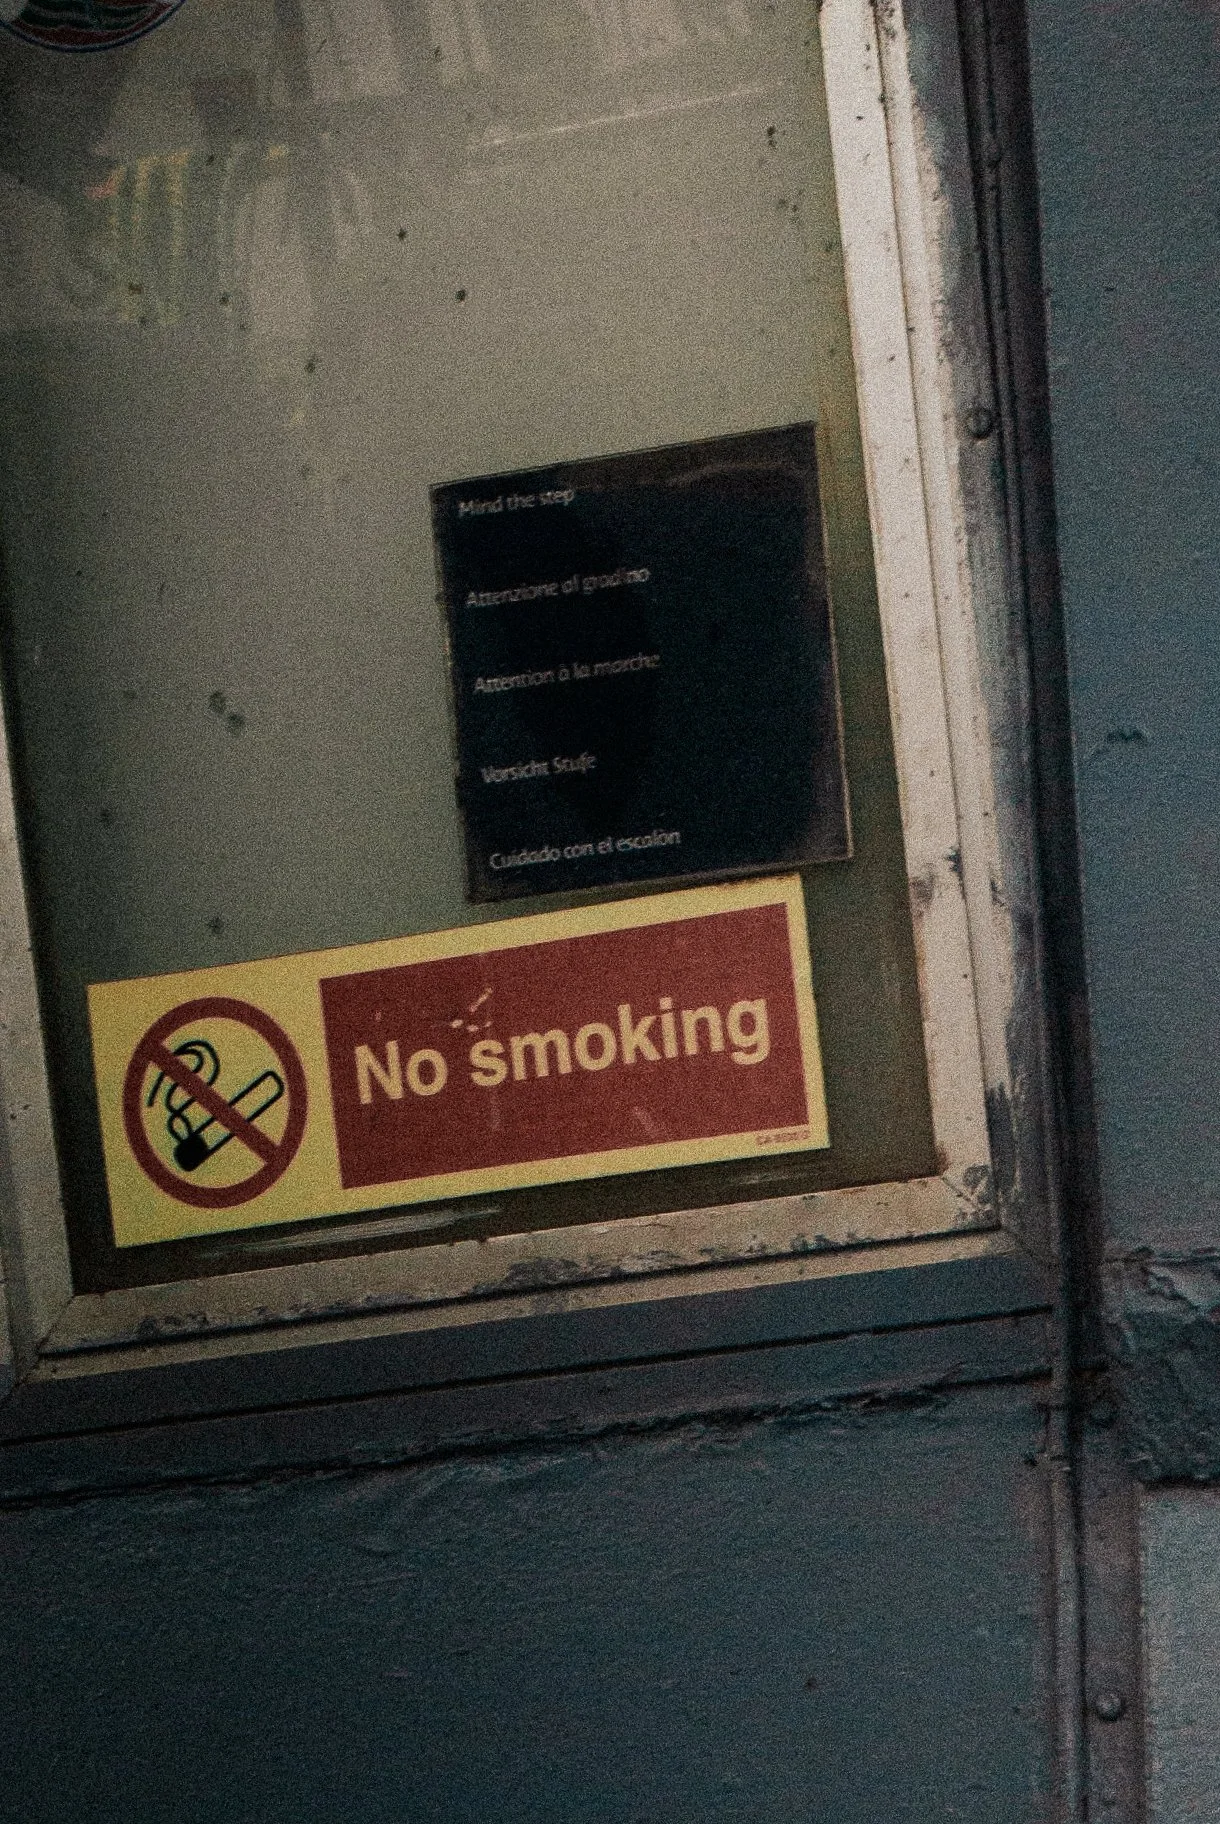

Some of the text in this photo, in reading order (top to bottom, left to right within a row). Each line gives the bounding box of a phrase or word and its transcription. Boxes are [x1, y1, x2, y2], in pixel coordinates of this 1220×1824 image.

[507, 494, 535, 510] the
[473, 670, 554, 694] Attention
[573, 658, 590, 679] la
[489, 845, 561, 869] Cuidado
[563, 843, 595, 859] con
[597, 836, 613, 854] el
[355, 997, 771, 1105] No smoking
